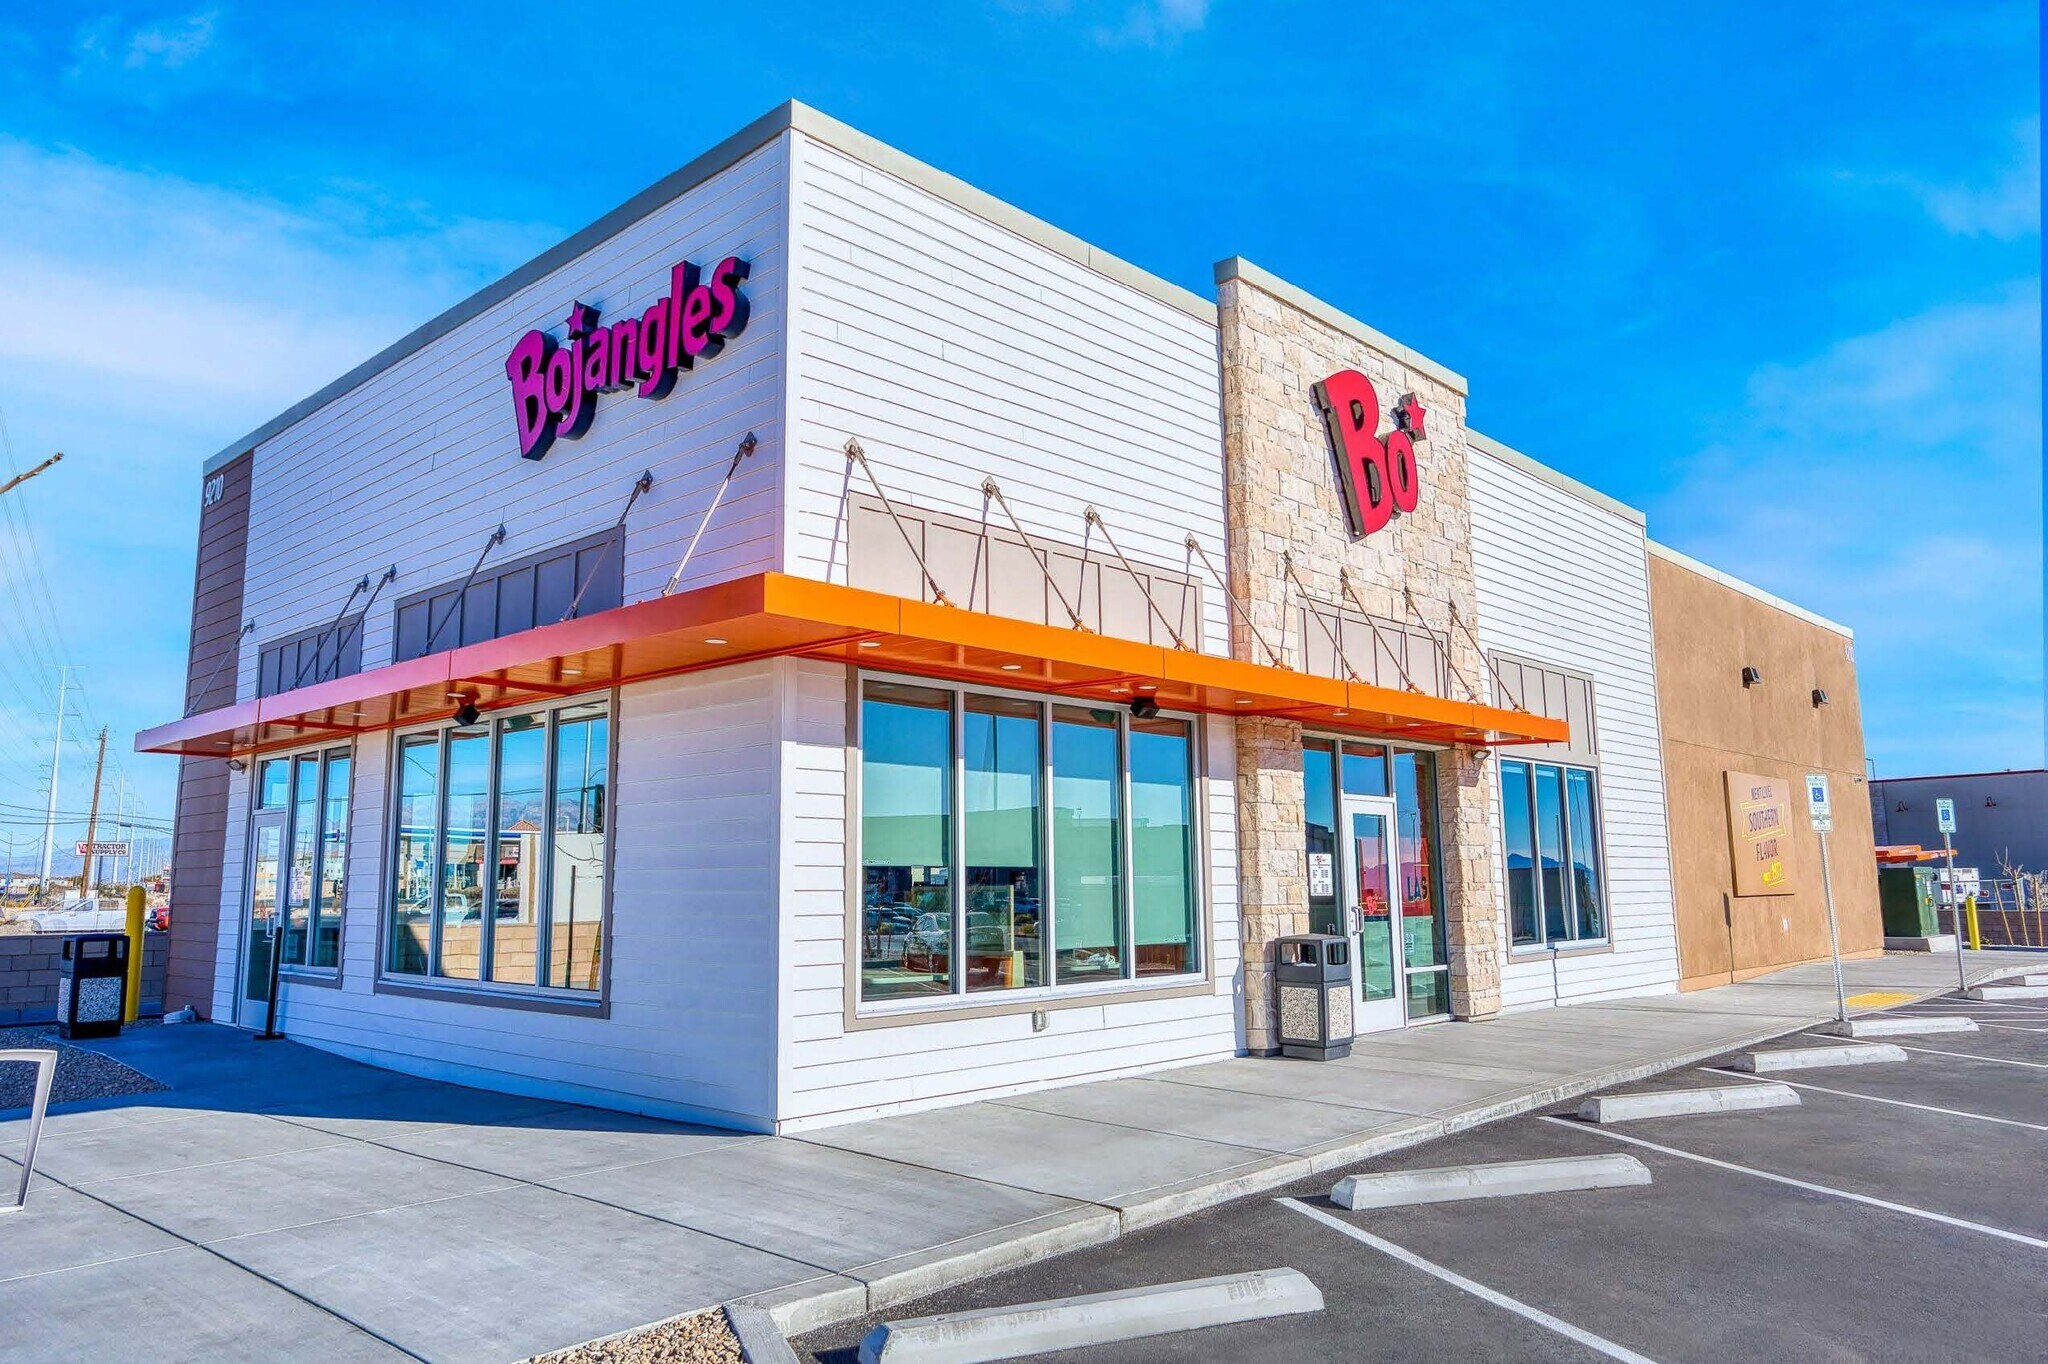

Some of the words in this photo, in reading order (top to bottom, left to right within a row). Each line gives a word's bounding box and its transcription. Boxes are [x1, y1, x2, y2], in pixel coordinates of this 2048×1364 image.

[505, 256, 751, 461] Bojangles
[1309, 370, 1426, 543] Bo
[1748, 808, 1780, 832] SOUTHERN
[1756, 839, 1778, 861] FLAVOR
[1407, 876, 1429, 903] LAS
